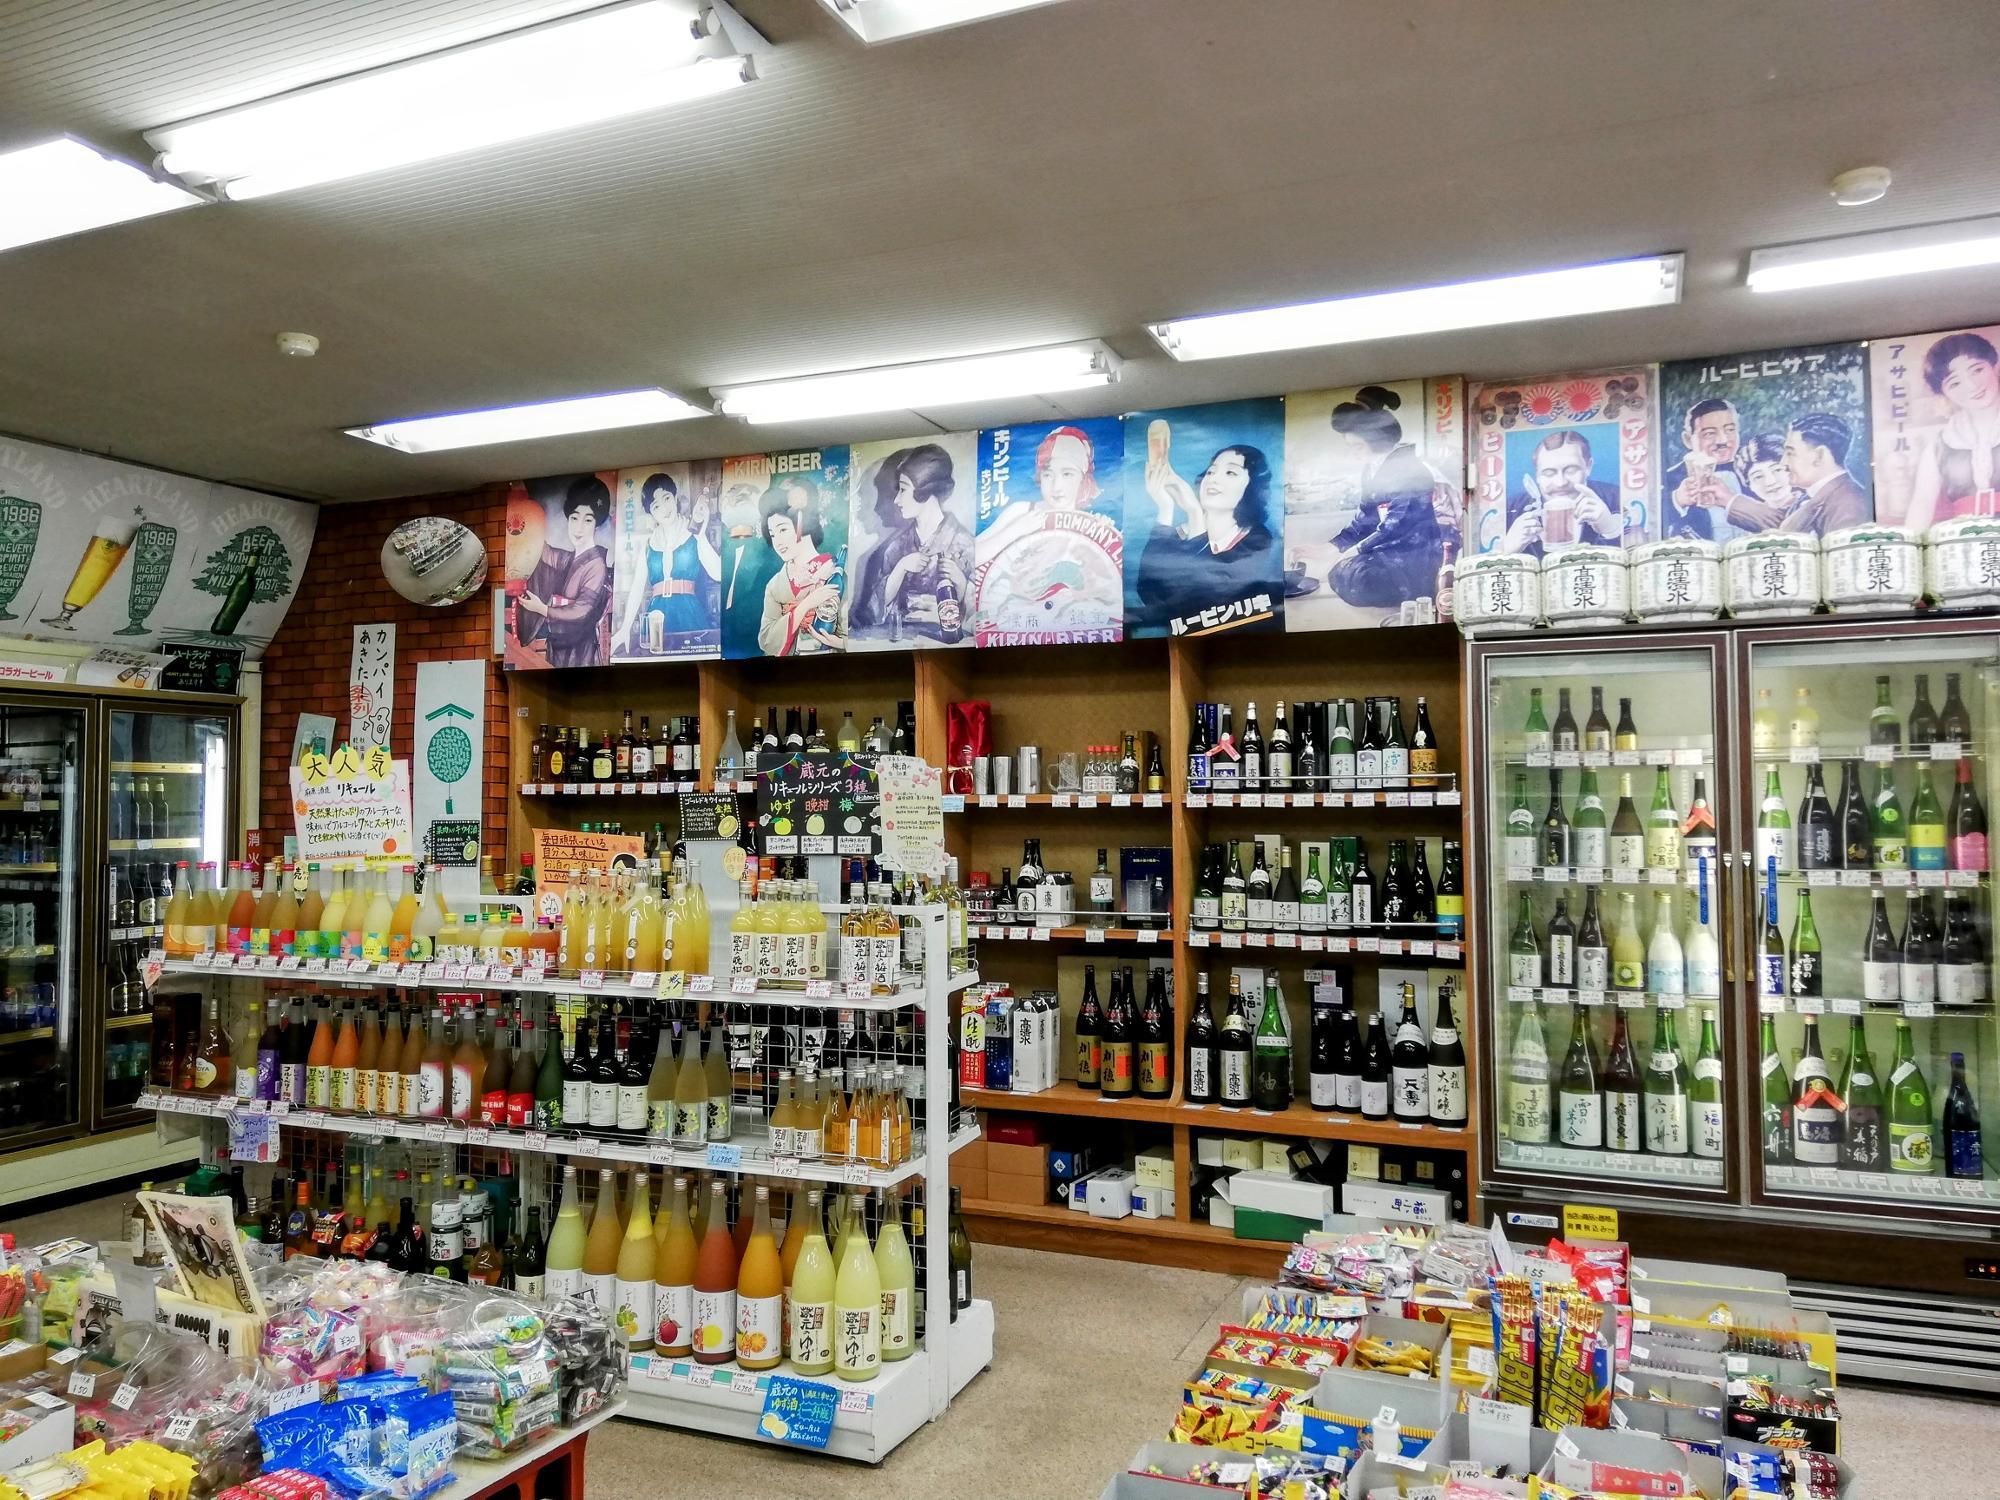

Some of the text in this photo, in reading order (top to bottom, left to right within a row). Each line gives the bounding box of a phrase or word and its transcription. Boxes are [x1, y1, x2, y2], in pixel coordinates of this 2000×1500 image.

[1887, 344, 1910, 451] アサヒビール
[1624, 420, 1648, 490] アサヒ
[734, 452, 821, 478] KIRIN BEER
[993, 430, 1010, 506] キリンビール
[1482, 432, 1503, 499] ビール
[3, 506, 39, 522] 1986
[144, 531, 175, 546] 1986
[242, 534, 276, 555] BEER
[6, 543, 34, 553] EVERY
[227, 551, 282, 566] WITH CLEAR
[255, 566, 274, 577] AND
[208, 575, 280, 591] MILD TASTE
[188, 661, 207, 670] ビール
[373, 629, 389, 699] カンパイ
[307, 751, 385, 781] 大人気
[799, 761, 842, 780] 蔵元の
[338, 783, 375, 797] リキュール
[769, 780, 842, 797] リキュールシリーズ
[770, 798, 795, 815] ゆず
[839, 798, 854, 812] 梅
[542, 832, 606, 848] 毎日頑張っている
[770, 1382, 798, 1396] 蔵元の
[771, 1397, 798, 1411] ゆず酒
[1756, 1426, 1807, 1440] ブラック
